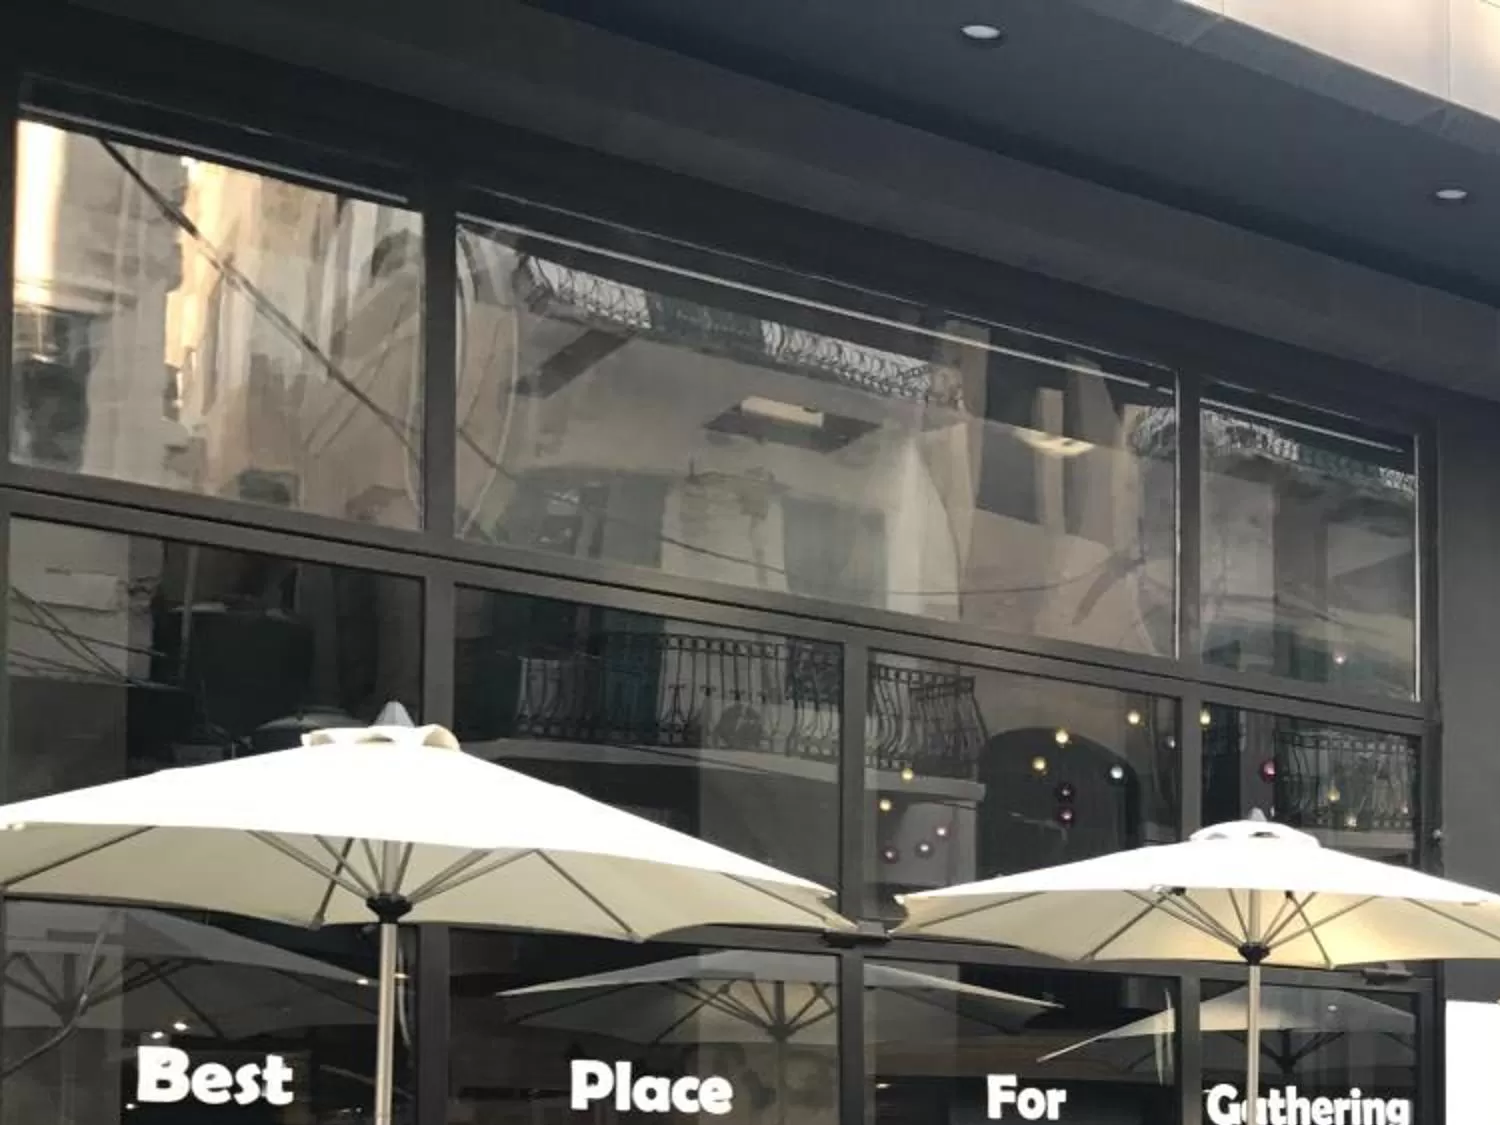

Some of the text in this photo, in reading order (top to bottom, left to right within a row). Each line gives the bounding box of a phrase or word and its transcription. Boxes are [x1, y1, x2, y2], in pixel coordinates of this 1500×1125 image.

[137, 1045, 294, 1105] Best
[571, 1059, 734, 1115] Place
[987, 1074, 1067, 1120] For
